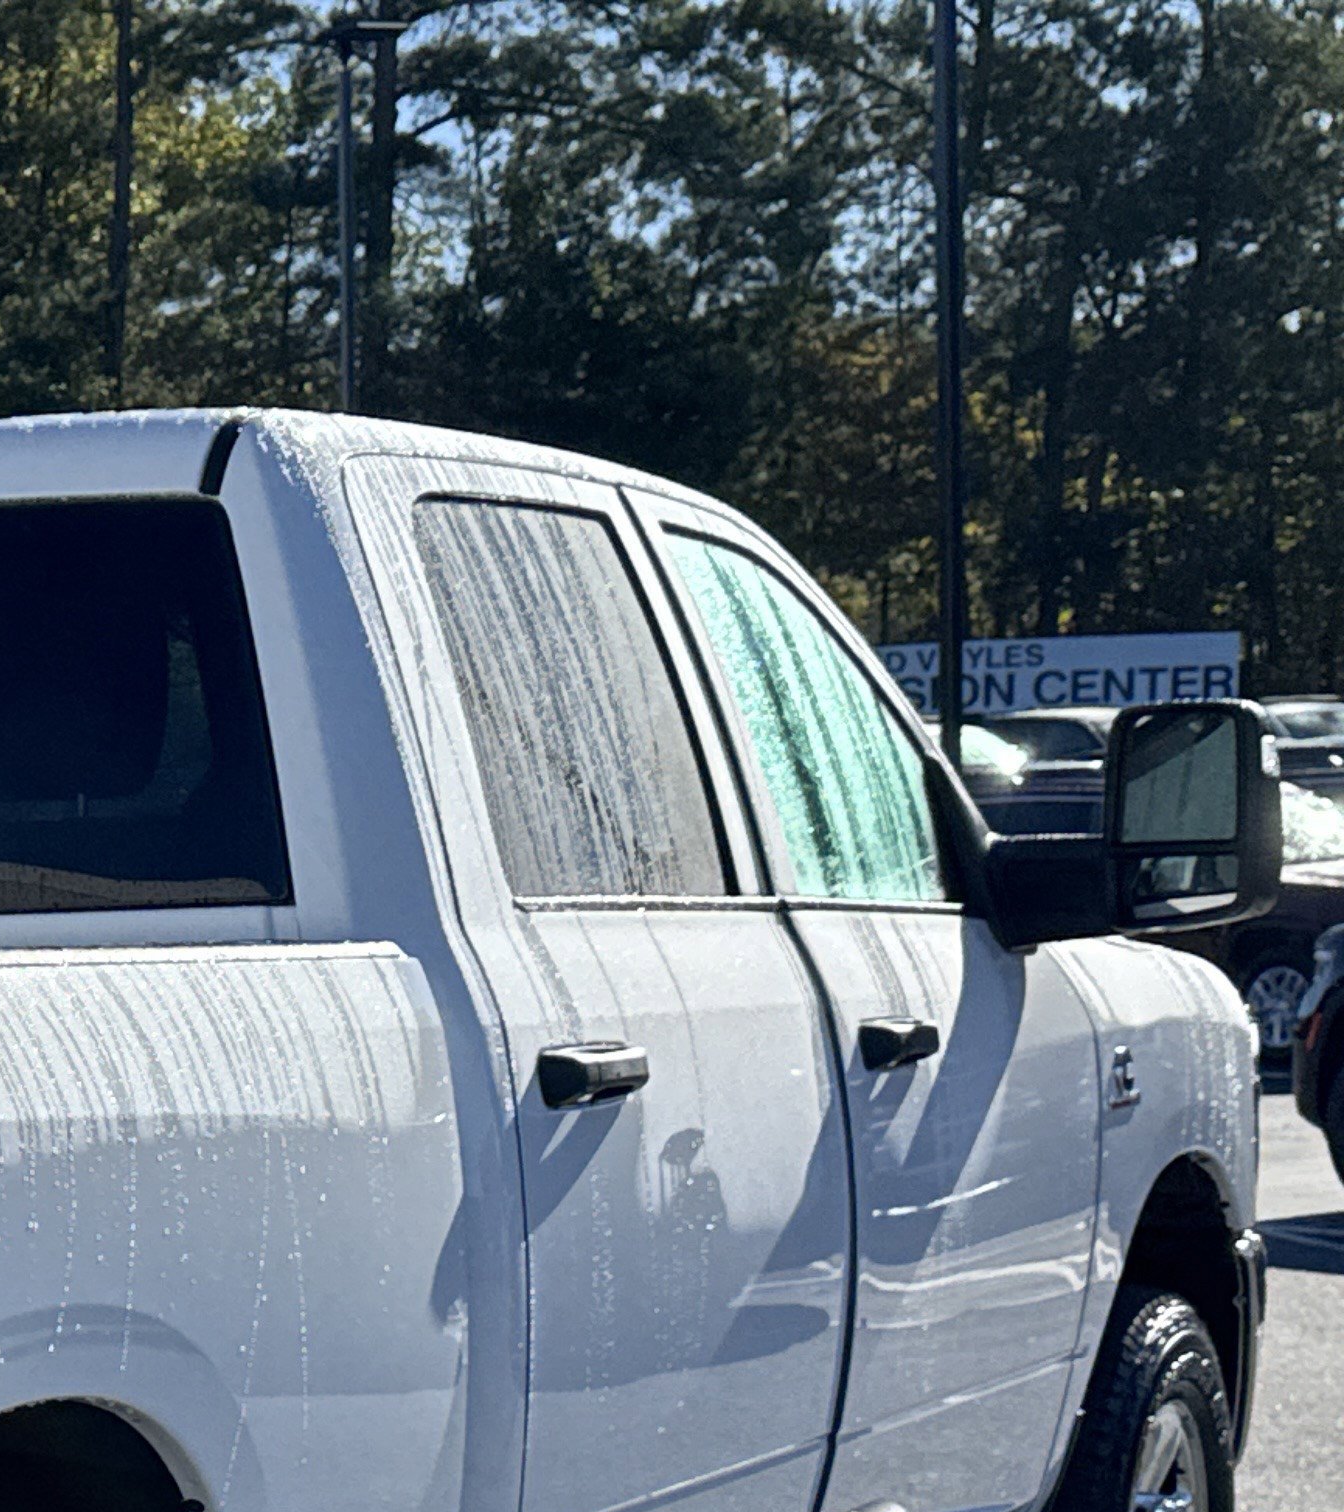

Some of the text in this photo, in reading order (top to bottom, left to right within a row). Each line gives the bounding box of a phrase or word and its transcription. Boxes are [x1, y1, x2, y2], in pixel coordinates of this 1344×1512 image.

[883, 643, 1045, 674] D VYLES
[1033, 665, 1233, 705] CENTER
